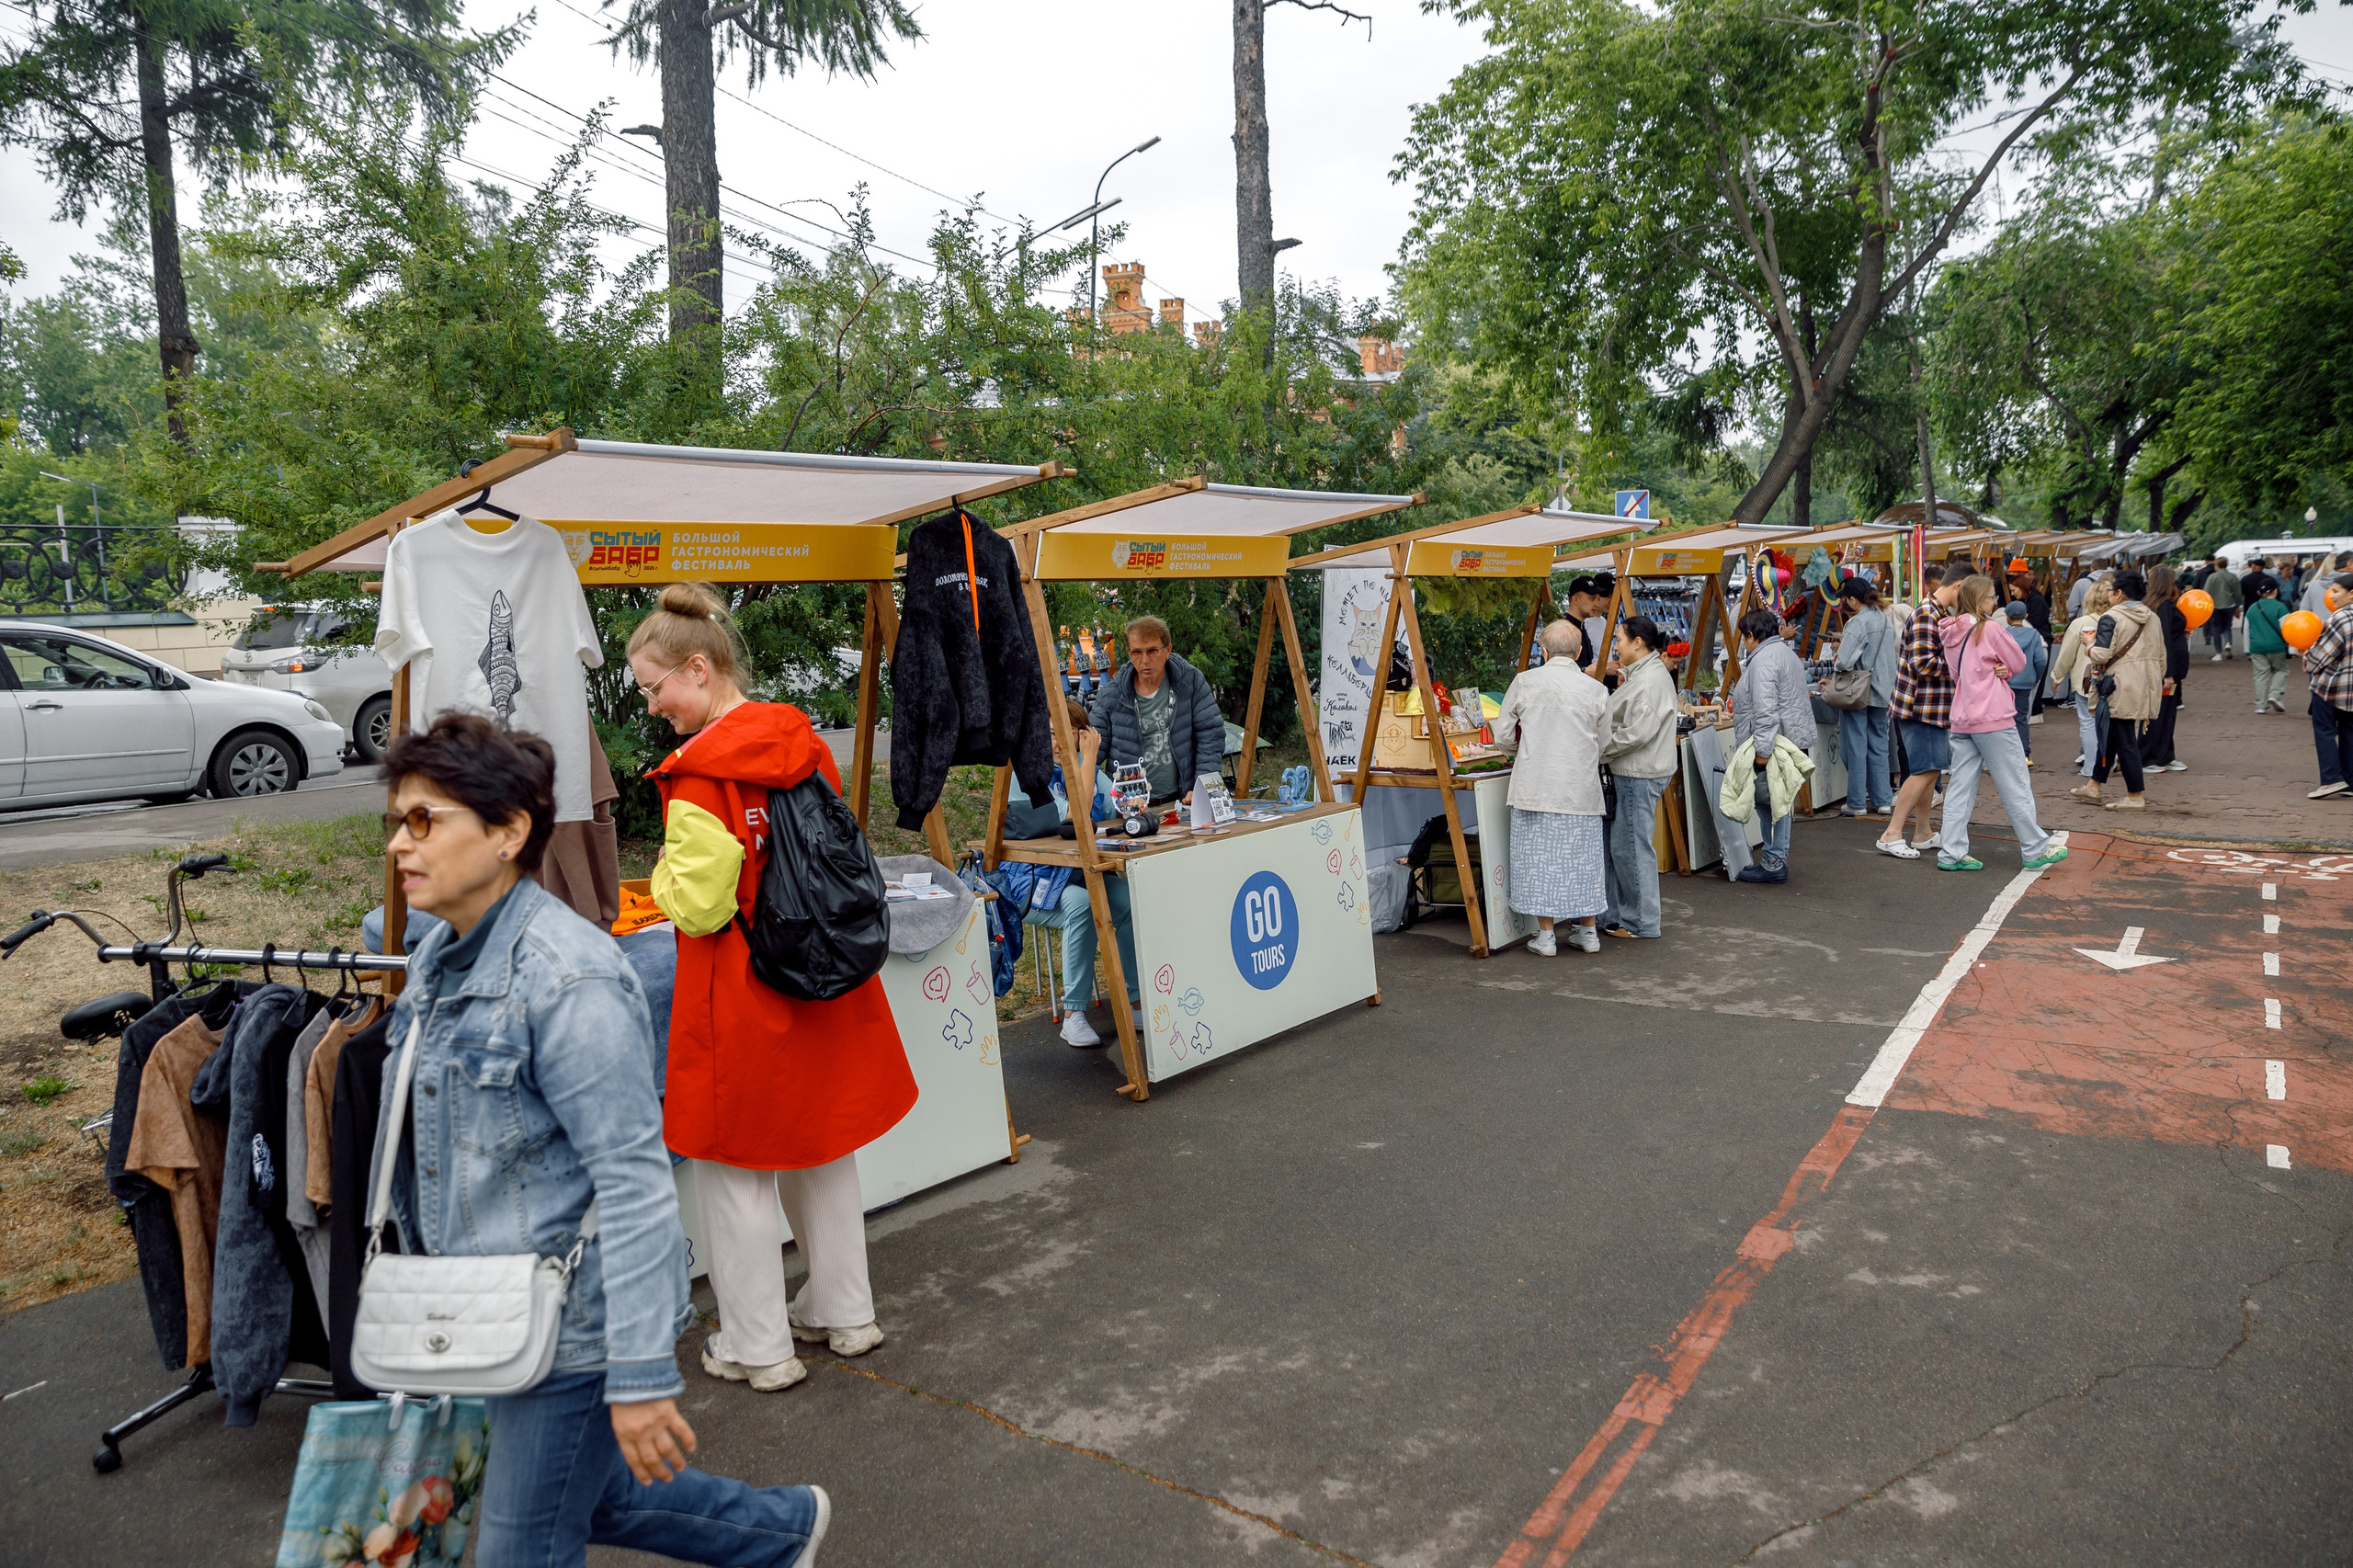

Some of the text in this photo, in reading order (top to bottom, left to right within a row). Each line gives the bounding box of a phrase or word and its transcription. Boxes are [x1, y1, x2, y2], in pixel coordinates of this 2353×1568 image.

[590, 529, 661, 546] СЫТЫЙ
[673, 531, 740, 543] БОЛЬШОЙ
[671, 545, 810, 557] ГАСТРОНОМИЧЕСКИЙ
[1130, 540, 1166, 552] СЫТЫЙ
[1171, 542, 1207, 551] БОЛЬШОЙ
[589, 547, 660, 564] БАБР
[1128, 552, 1165, 565] БАБР
[1170, 551, 1243, 561] ГАСТРОНОМИЧЕСКИЙ
[671, 559, 751, 571] ФЕСТИВАЛЬ
[1168, 562, 1211, 570] ФЕСТИВАЛЬ
[1338, 580, 1391, 626] МОЖЕТ ПО ЧА
[1076, 662, 1091, 672] 66E
[1096, 661, 1111, 670] 75A
[745, 807, 770, 825] EV
[1245, 885, 1282, 943] GO
[1251, 943, 1285, 974] TOURS
